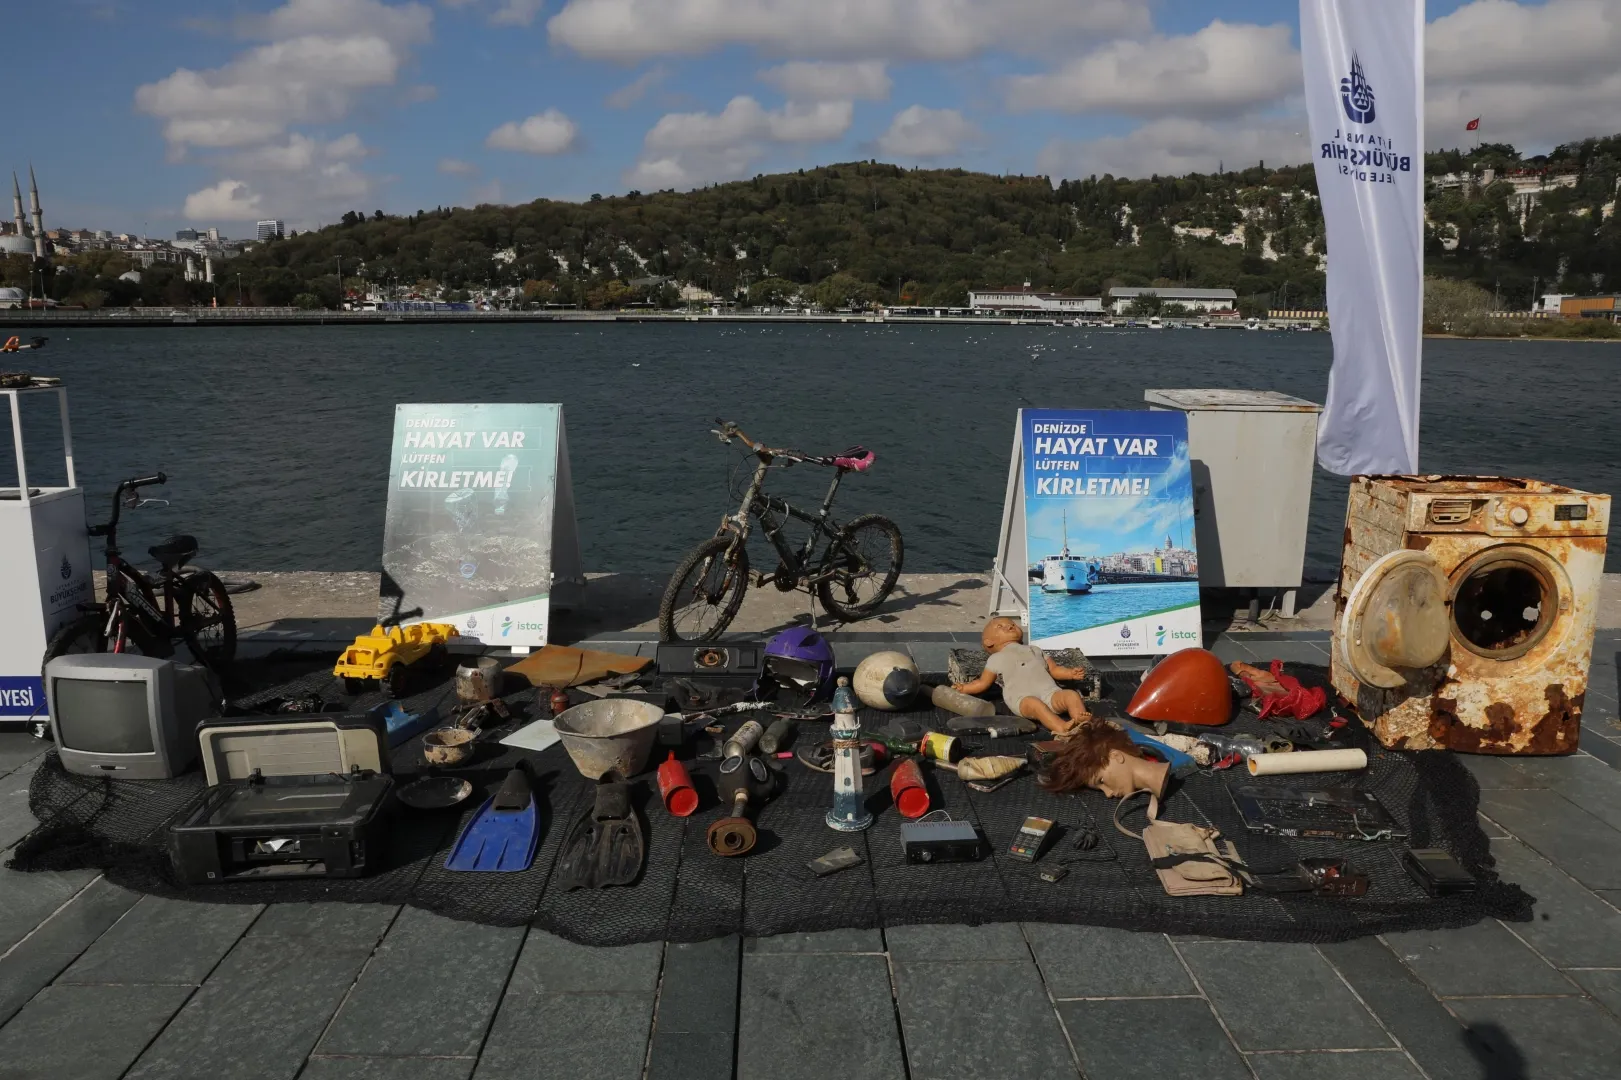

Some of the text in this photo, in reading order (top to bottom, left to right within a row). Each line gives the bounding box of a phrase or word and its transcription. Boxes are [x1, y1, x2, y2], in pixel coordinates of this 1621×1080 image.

[405, 417, 456, 428] DENİZDE
[1034, 421, 1087, 434] DENİZDE
[404, 431, 526, 449] HAYAT VAR
[1035, 437, 1158, 456] HAYAT VAR
[402, 452, 446, 464] LÜTFEN
[1035, 458, 1080, 471] LÜTFEN
[400, 466, 514, 488] KİRLETME!
[1036, 473, 1151, 496] KİRLETME!
[517, 621, 543, 632] istaç
[1171, 630, 1197, 641] istaç
